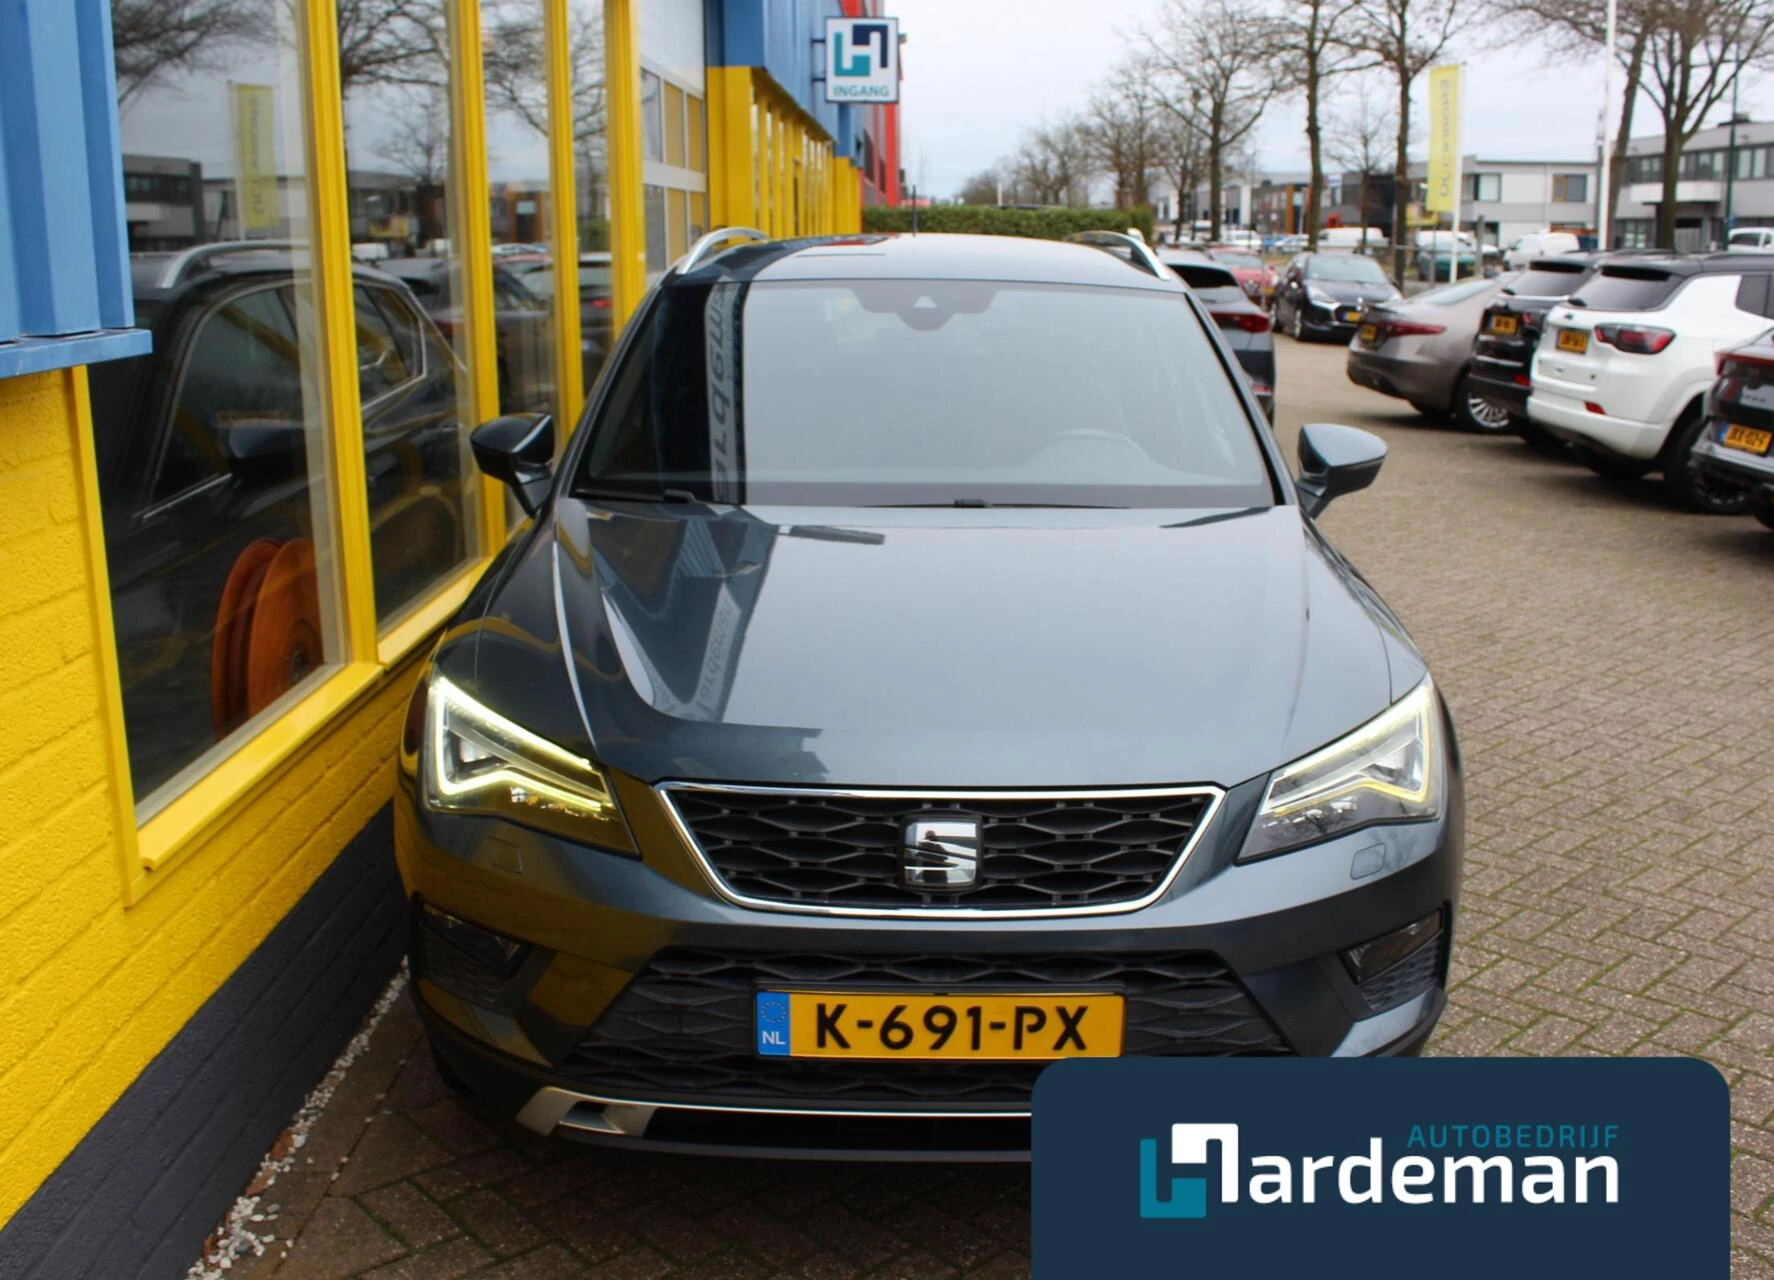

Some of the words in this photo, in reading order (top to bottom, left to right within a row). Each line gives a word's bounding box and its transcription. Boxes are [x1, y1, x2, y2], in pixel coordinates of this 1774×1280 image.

[833, 85, 890, 98] INGANG
[761, 1030, 786, 1046] NL
[816, 1003, 1088, 1051] K-691-PX
